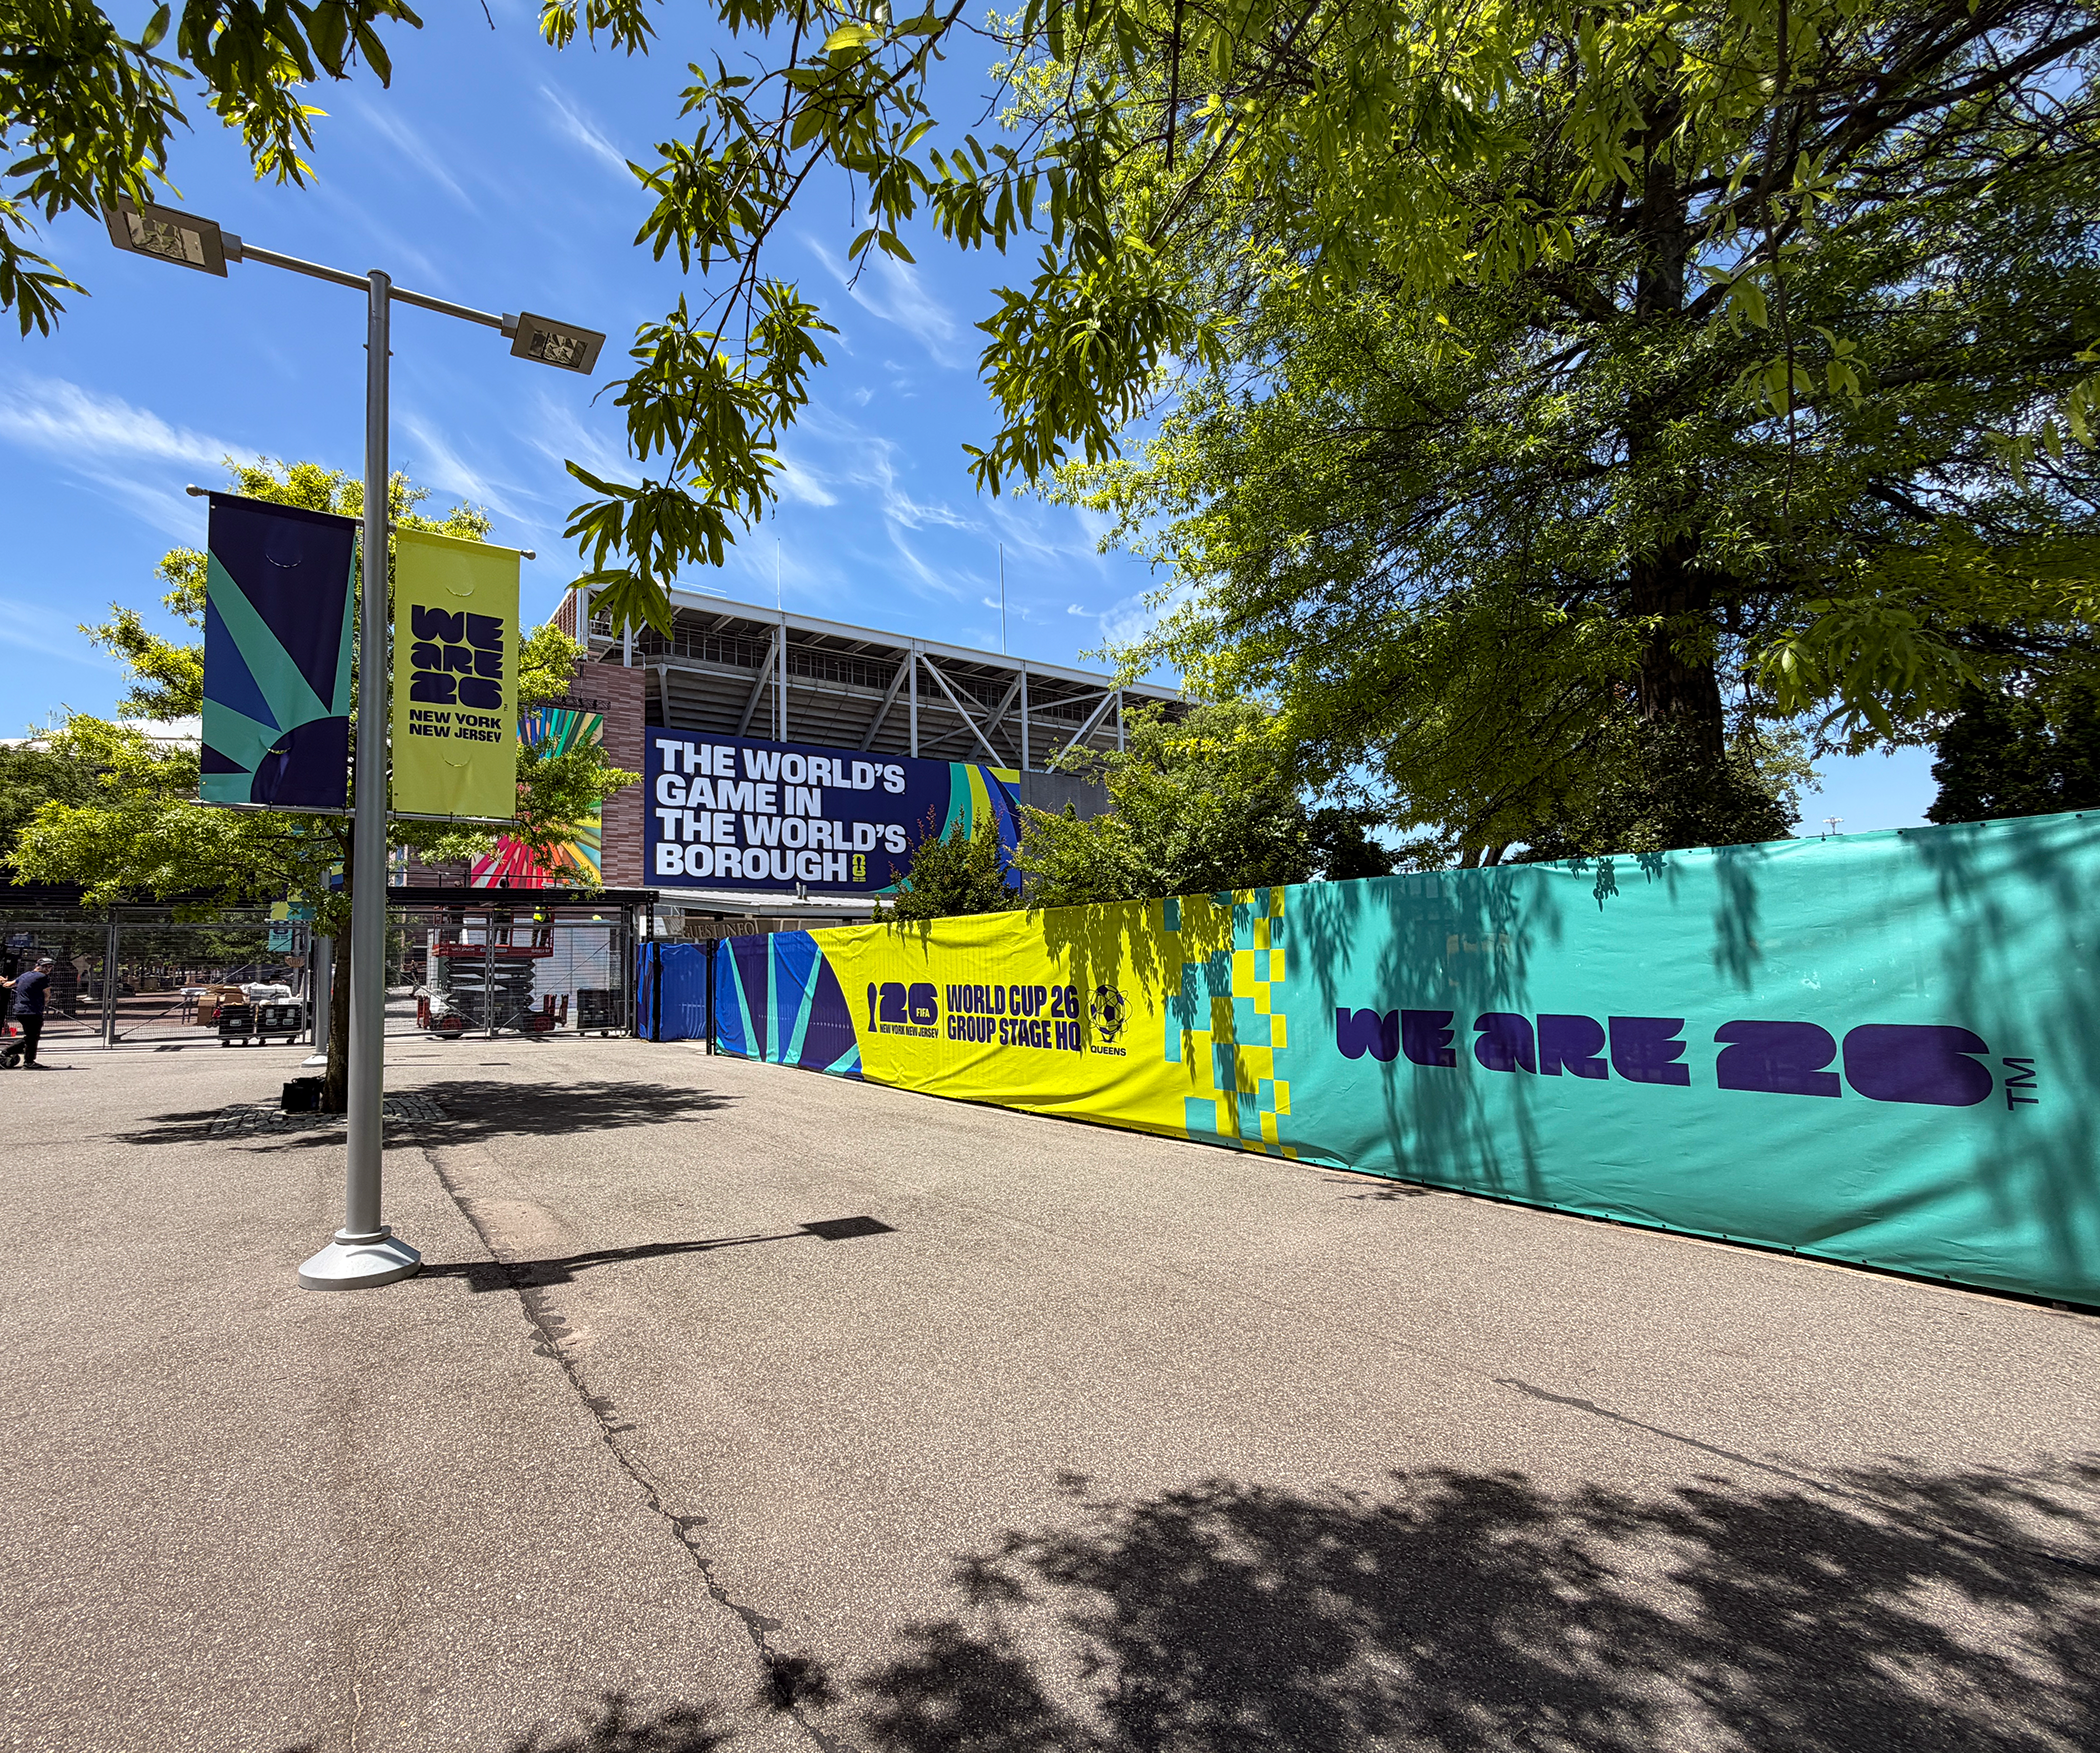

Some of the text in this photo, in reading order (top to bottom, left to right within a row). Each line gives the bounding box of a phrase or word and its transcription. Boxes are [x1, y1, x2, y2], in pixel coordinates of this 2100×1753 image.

[411, 604, 504, 652] WE
[410, 642, 503, 680] ARE
[410, 671, 503, 710] 26
[409, 709, 502, 729] NEW YORK
[409, 723, 502, 743] NEW JERSEY
[655, 738, 906, 794] THE WORLD'S
[656, 773, 822, 817] GAME IN
[655, 808, 907, 853] THE WORLD'S
[656, 842, 848, 882] BOROUGH
[682, 921, 755, 939] GUEST INFO
[879, 982, 939, 1026] 26
[915, 1007, 931, 1018] FIFA
[946, 984, 1080, 1019] WORLD CUP 26
[880, 1023, 939, 1039] NEW YORK NEW JERSEY
[947, 1015, 1083, 1053] GROUP STAGE HQ
[1090, 1045, 1127, 1057] QUEENS
[1335, 1007, 1457, 1068] WE
[1473, 1012, 1692, 1087] ARE
[1713, 1019, 1995, 1107] 26
